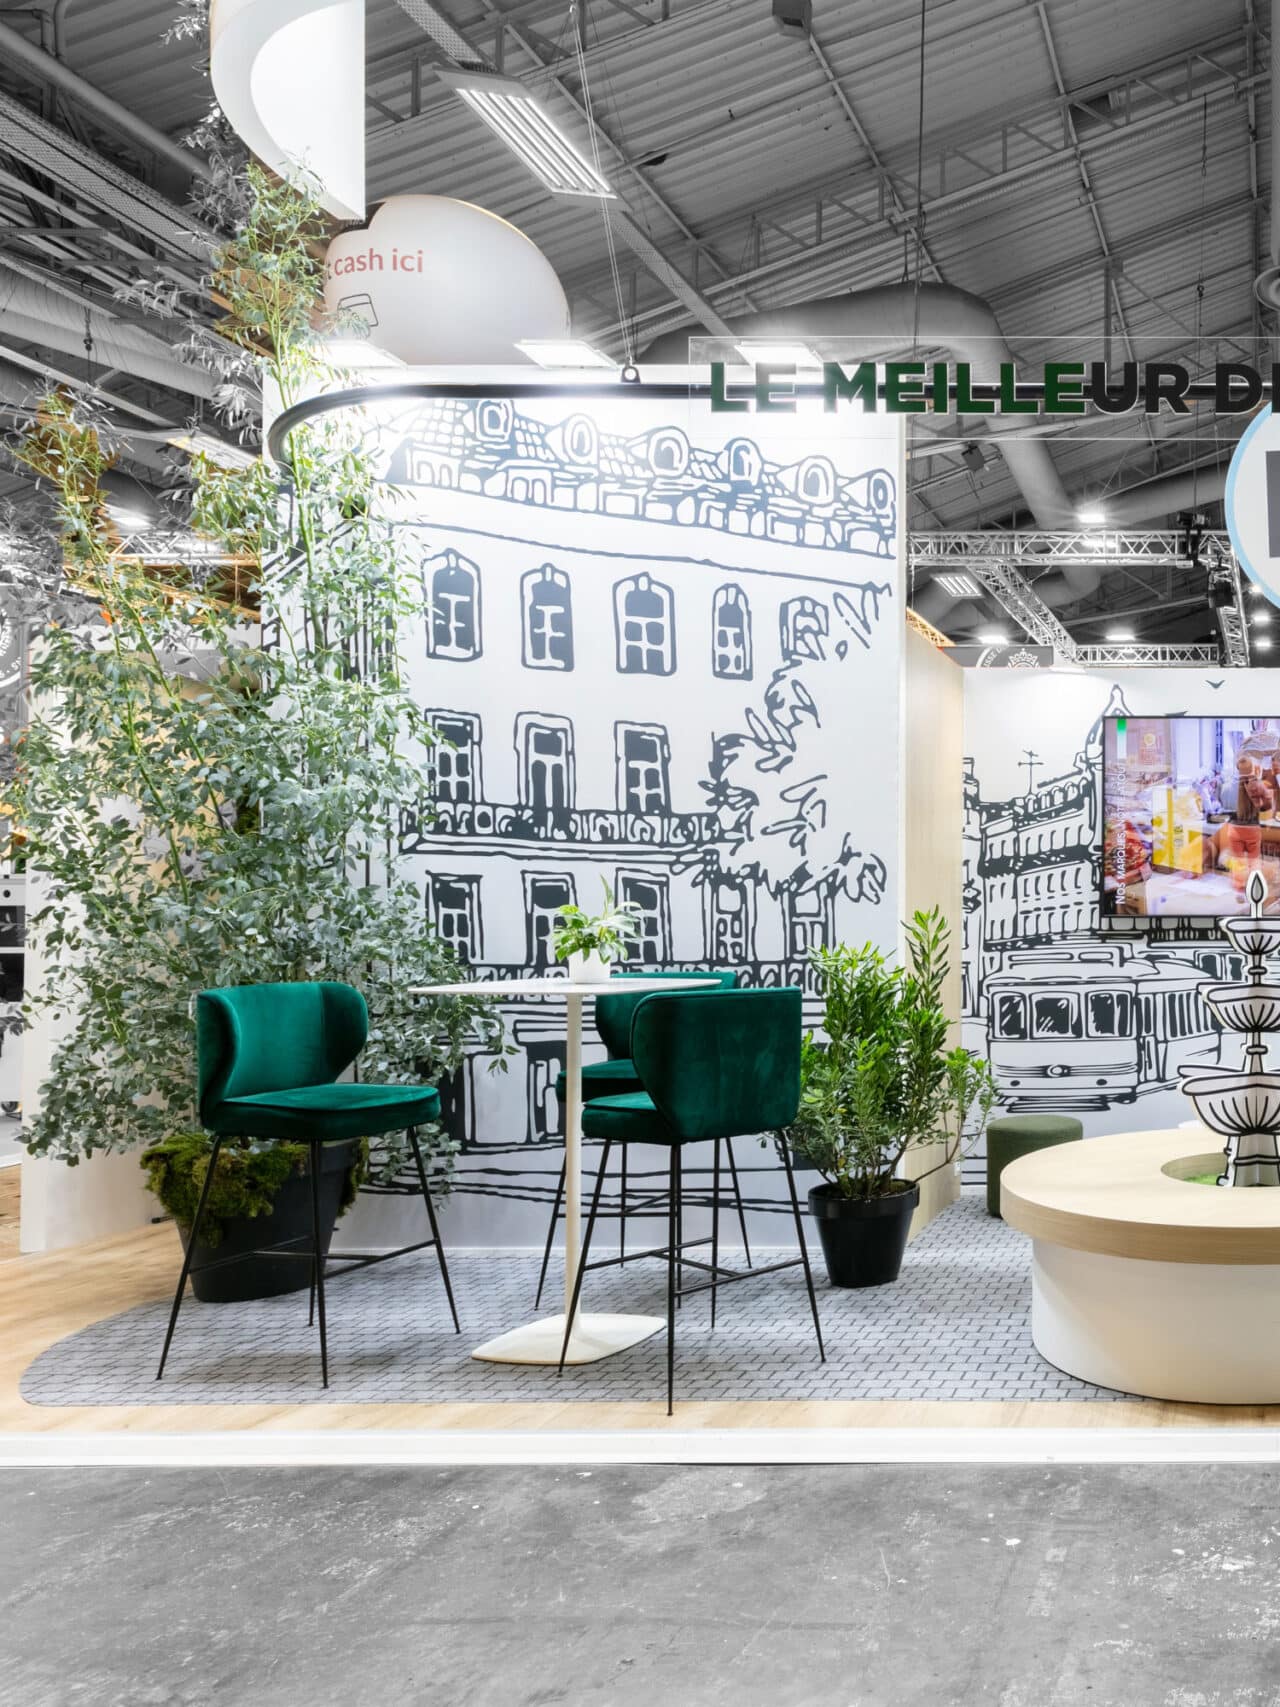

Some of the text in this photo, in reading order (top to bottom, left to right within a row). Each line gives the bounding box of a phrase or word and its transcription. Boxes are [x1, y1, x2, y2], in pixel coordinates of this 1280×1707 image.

[334, 247, 383, 276] cash
[392, 248, 423, 273] ici
[710, 361, 797, 413] LE
[823, 361, 1191, 414] MEILLEUR
